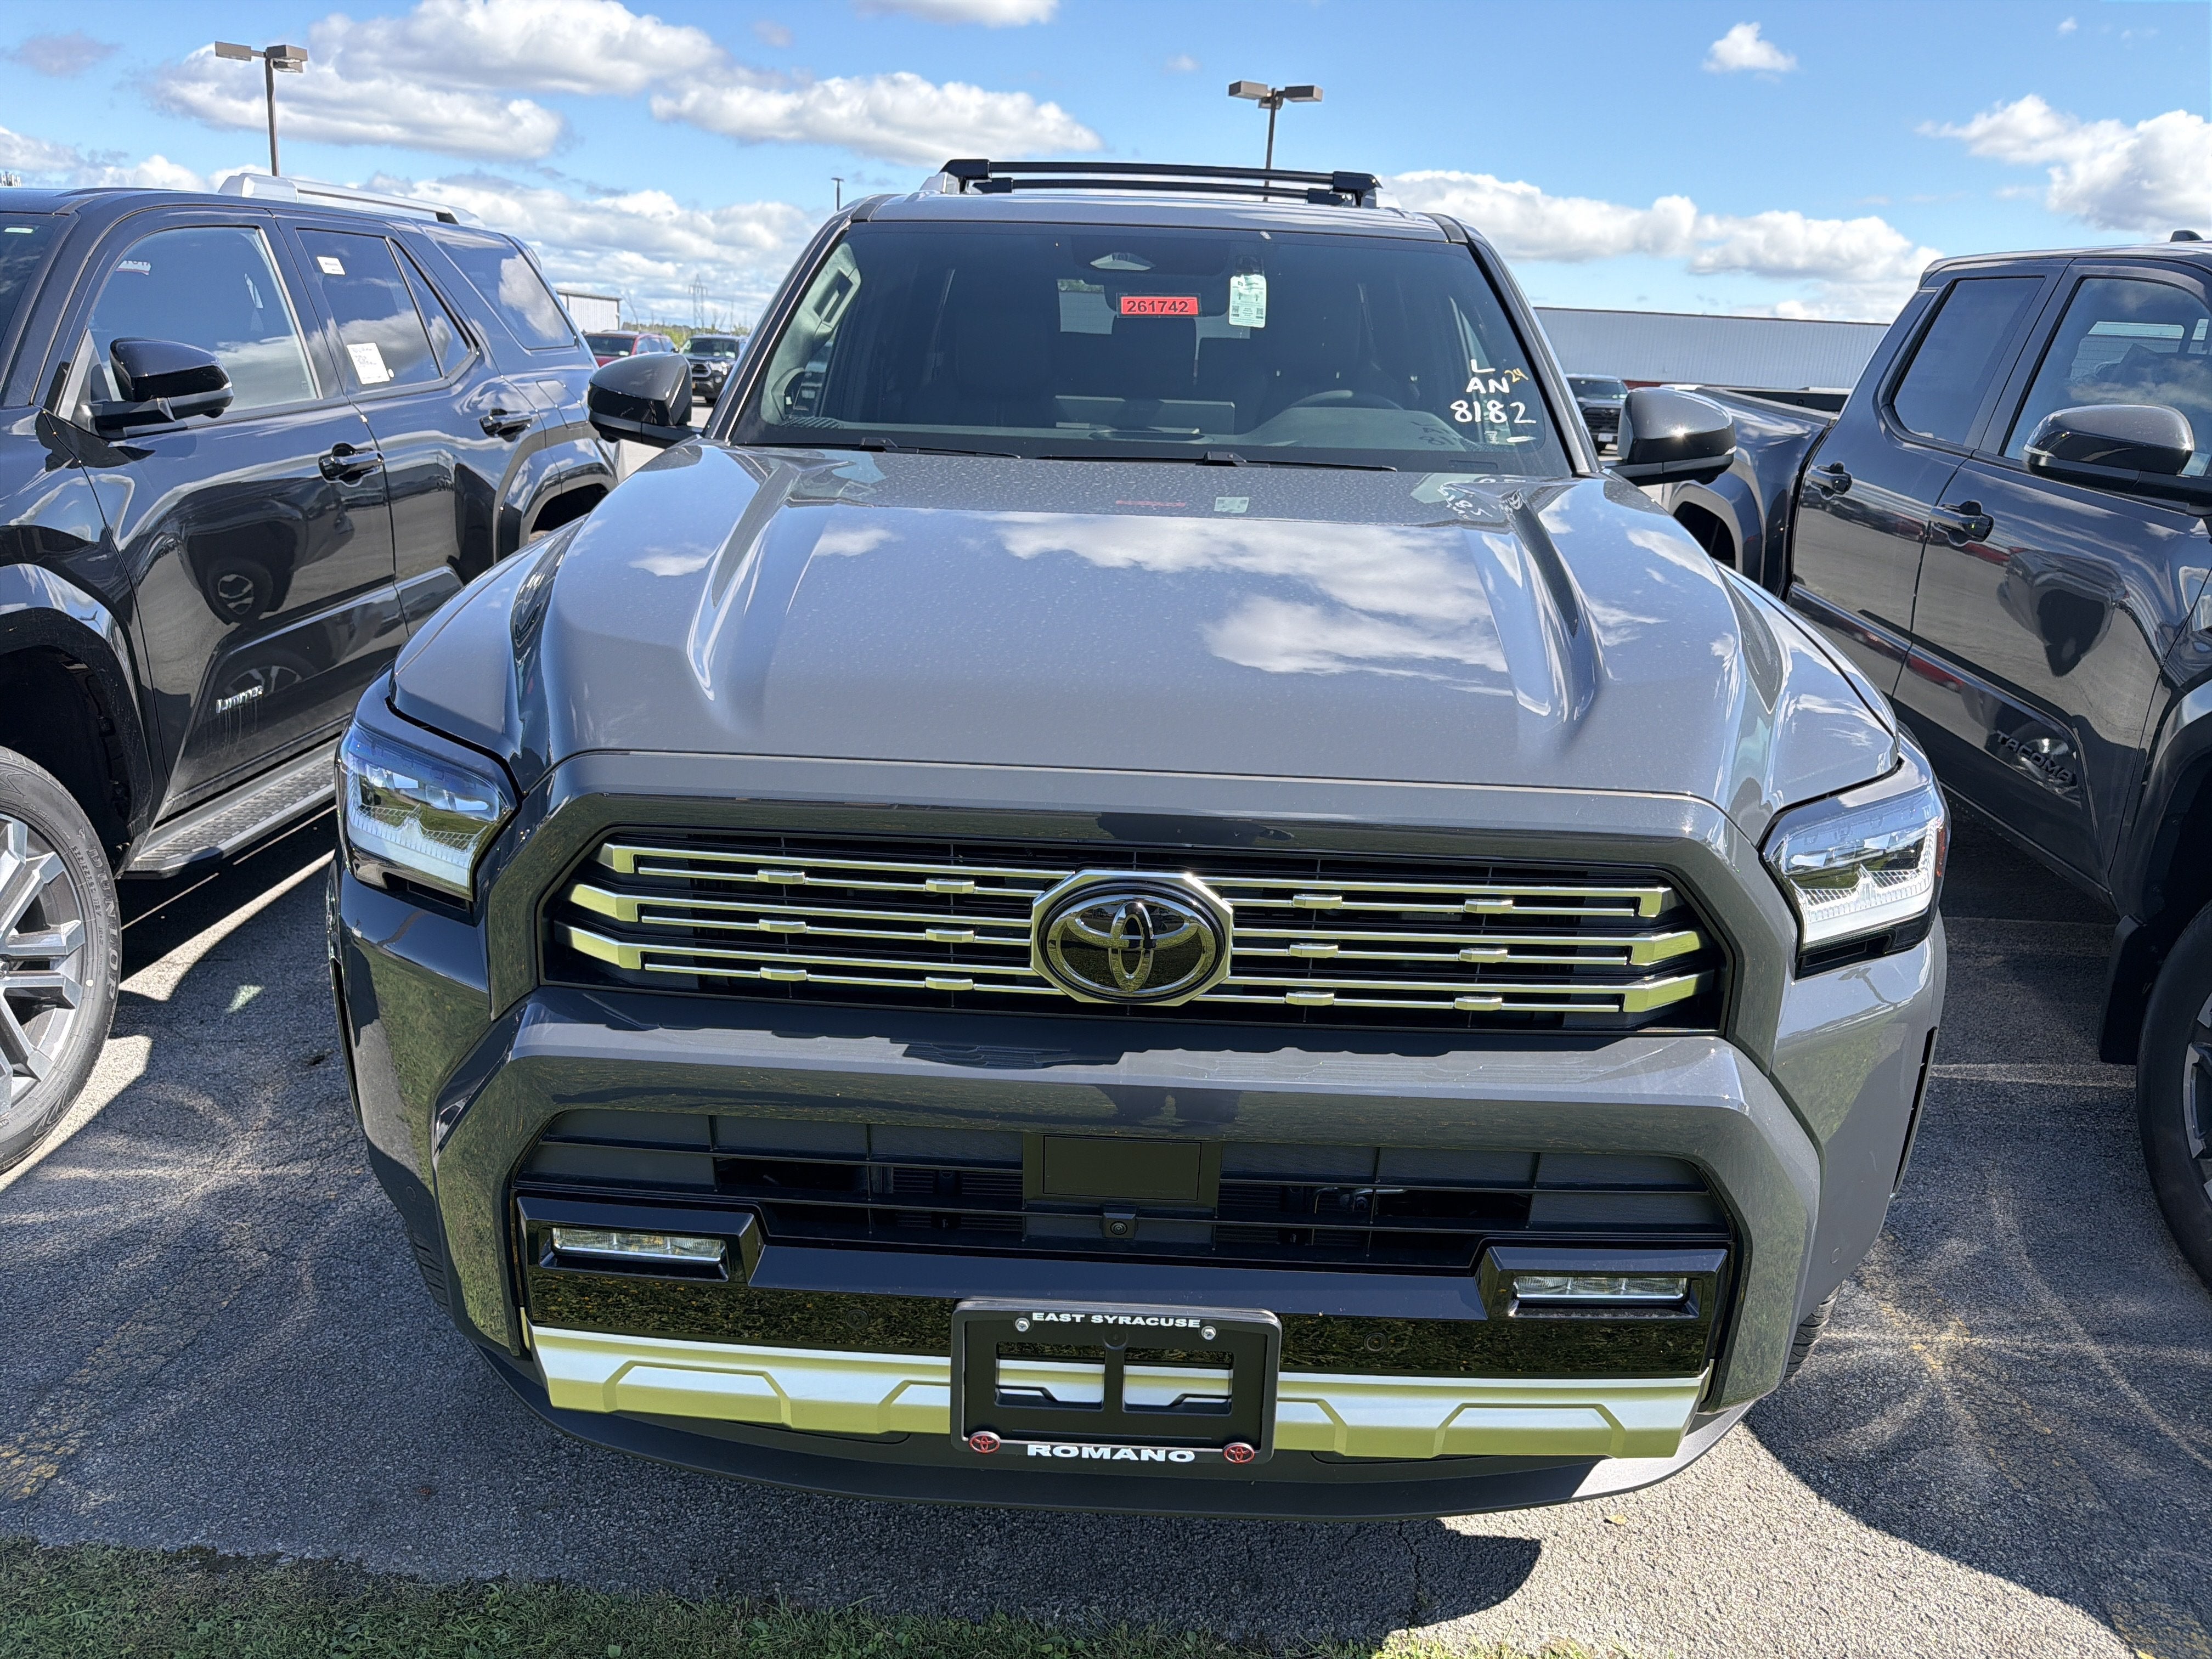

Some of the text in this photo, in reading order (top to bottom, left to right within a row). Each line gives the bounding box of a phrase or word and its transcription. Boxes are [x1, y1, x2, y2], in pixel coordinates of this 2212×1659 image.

[1126, 300, 1189, 313] 261742
[1470, 359, 1496, 373] L
[1466, 377, 1510, 394] AN
[1450, 399, 1537, 424] 8182
[86, 848, 119, 1000] DUNLOP
[1032, 1312, 1201, 1328] EAST SYRACUSE
[1027, 1444, 1195, 1462] ROMANO
